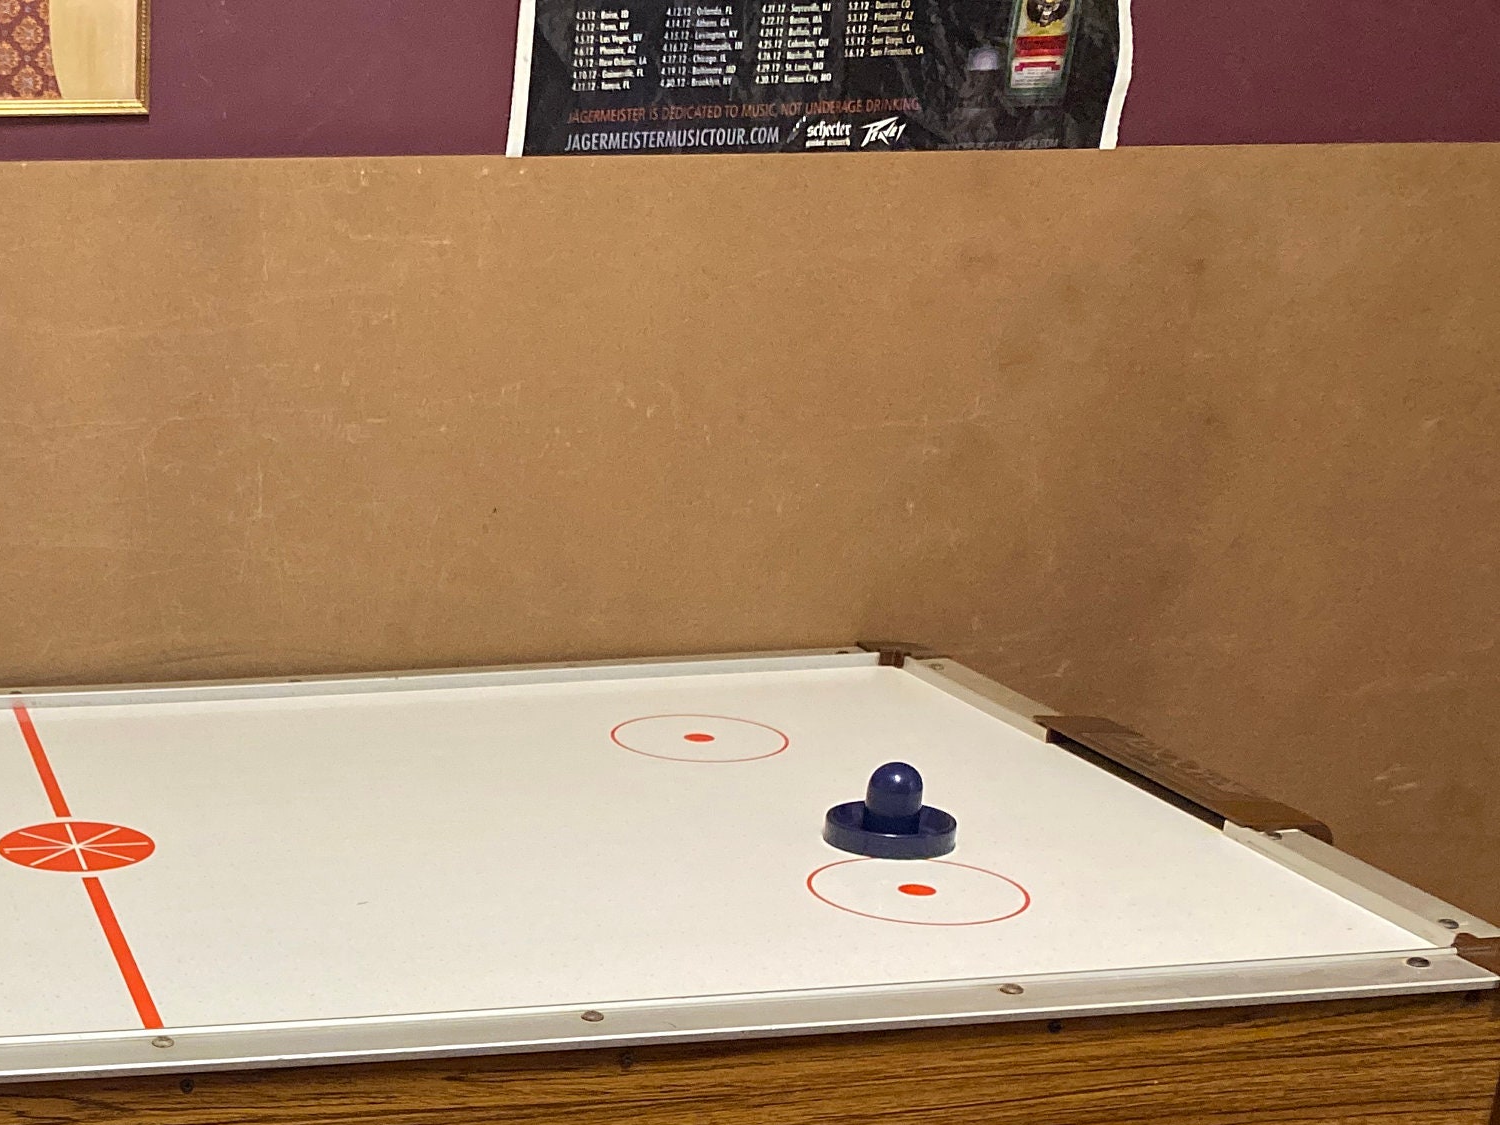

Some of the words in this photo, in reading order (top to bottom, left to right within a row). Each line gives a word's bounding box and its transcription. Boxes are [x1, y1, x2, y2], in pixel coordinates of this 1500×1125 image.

[650, 107, 658, 121] IS
[662, 104, 722, 121] DEDICATED
[725, 103, 739, 118] TO
[781, 102, 805, 117] NOT
[805, 100, 862, 116] UNDERAGE
[565, 126, 779, 151] JAGERMEISTERMUSICTOUR.COM
